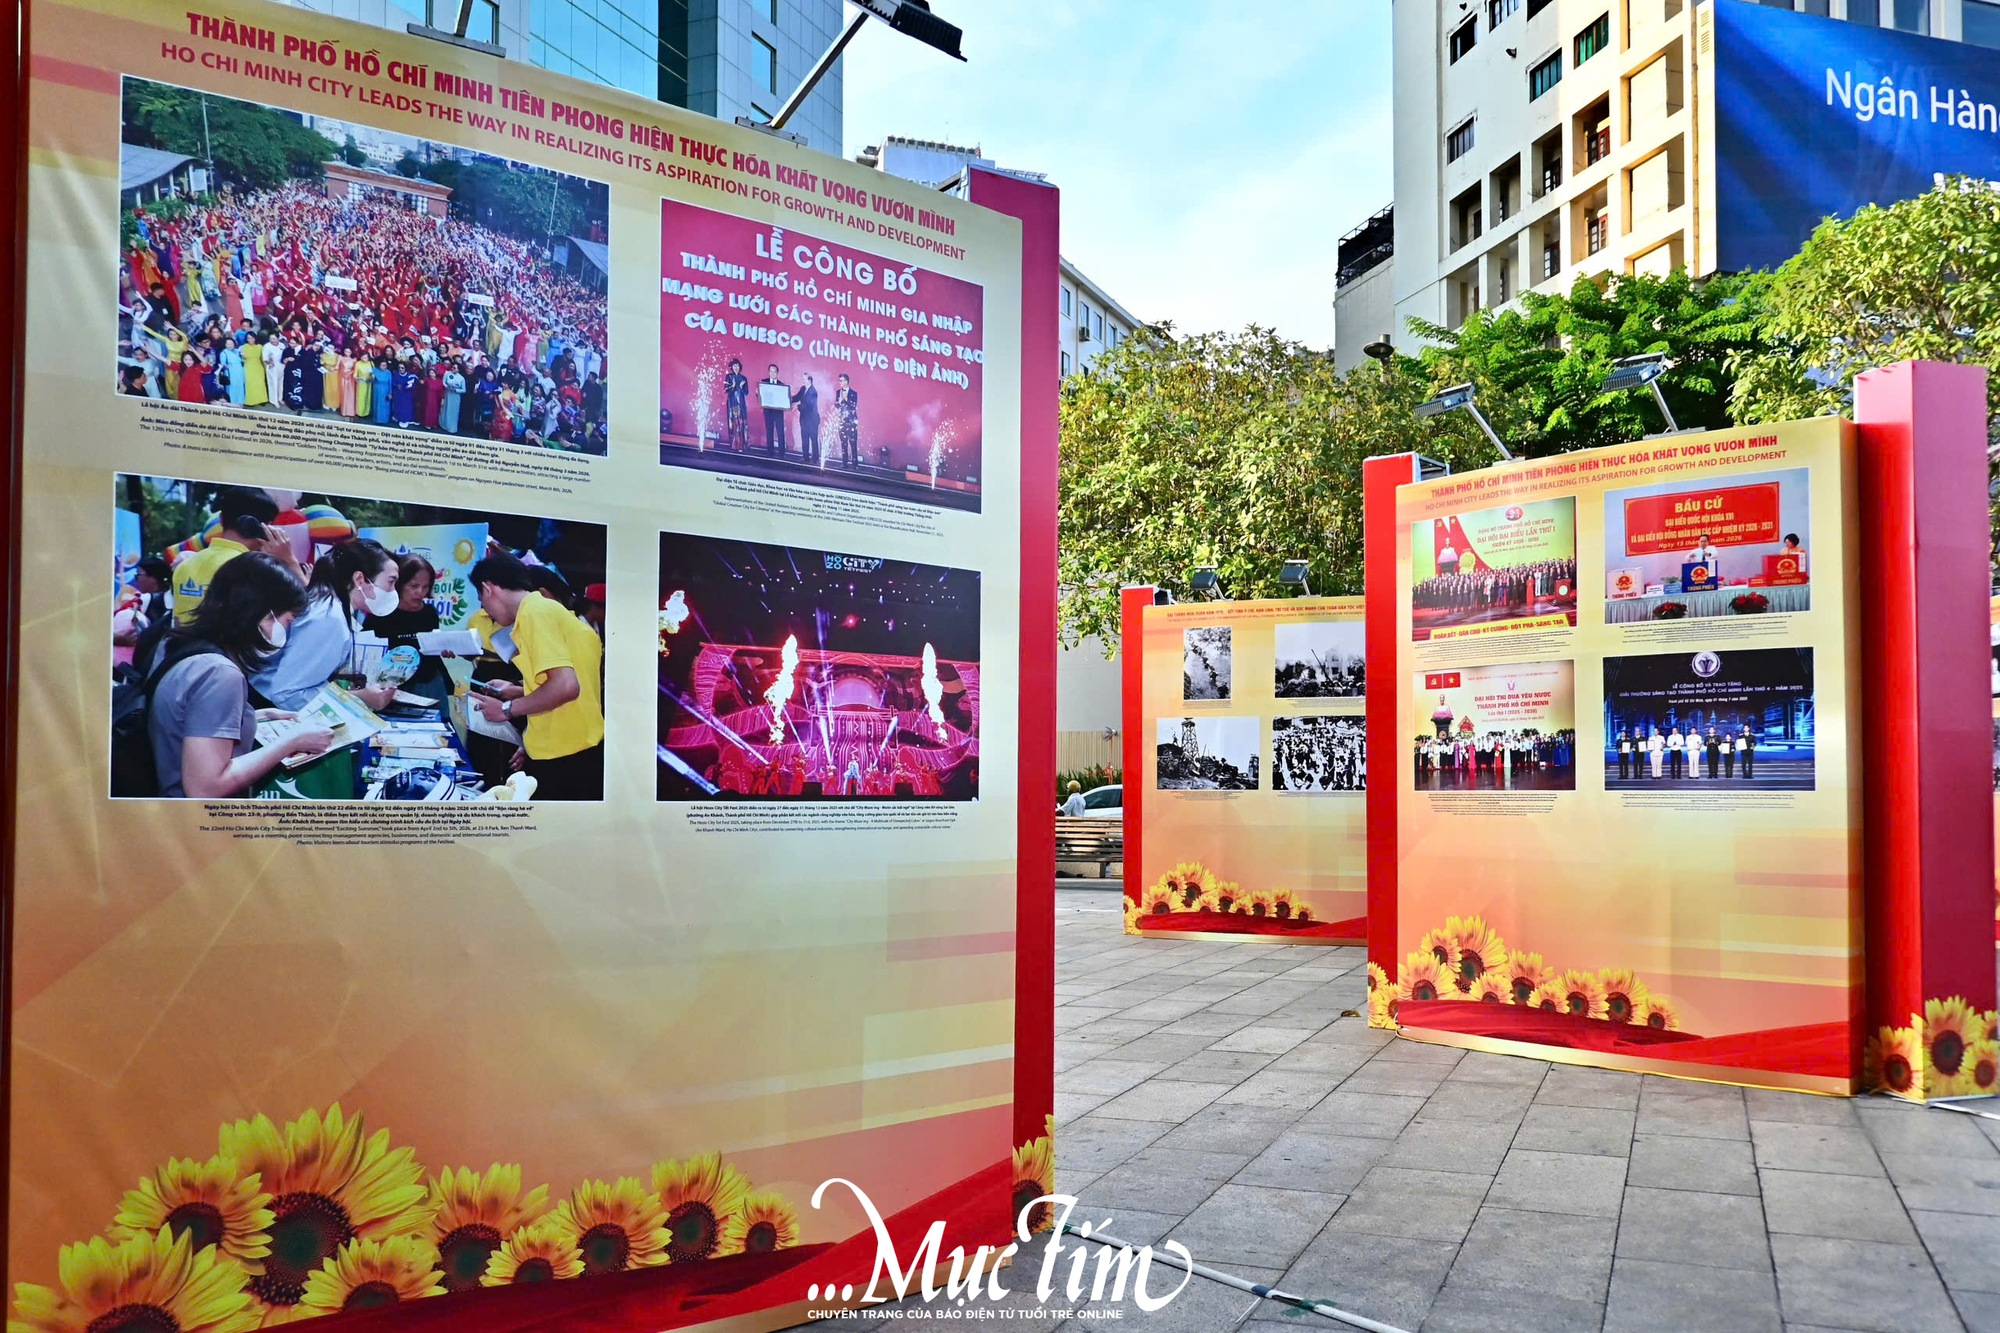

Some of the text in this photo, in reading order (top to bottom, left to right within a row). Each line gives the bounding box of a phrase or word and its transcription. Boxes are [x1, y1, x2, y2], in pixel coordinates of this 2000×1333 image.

[187, 12, 275, 53] THÀNH
[284, 38, 337, 66] PHỐ
[345, 50, 380, 76] HỒ
[388, 61, 428, 88] CHÍ
[434, 71, 492, 104] MINH
[499, 88, 544, 118] TIÊN
[552, 102, 624, 139] PHONG
[630, 123, 674, 153] HIỆN
[679, 137, 727, 167] THỰC
[733, 152, 771, 179] HÓA
[776, 164, 818, 193] KHÁT
[822, 178, 867, 208] VỌNG
[872, 194, 914, 223] VƯƠN
[918, 209, 955, 236] MÌNH
[1826, 68, 2000, 134] Ngân Hàn
[162, 42, 966, 261] HO CHI MINH CITY LEADS THE WAY IN REALIZING ITS ASPIRATION FOR GROWTH AND DEVELOPMENT
[680, 252, 972, 334] THÀNH PHỐ HỒ CHÍ MINH GIA NHẬP
[756, 226, 918, 296] LỄ CÔNG BỐ
[662, 277, 724, 304] MẠNG
[729, 293, 770, 315] LƯỚI
[776, 304, 813, 325] CÁC
[818, 314, 870, 339] THÀNH
[876, 327, 907, 347] PHỐ
[912, 334, 952, 357] SÁNG
[684, 312, 969, 390] CỦA UNESCO (LĨNH VỰC ĐIỆN ẢNH)
[1435, 501, 1447, 509] CHI
[1446, 498, 1463, 507] MINH
[1462, 495, 1477, 504] CITY
[1479, 490, 1499, 501] LEADS
[1498, 488, 1512, 497] THE
[1514, 485, 1531, 494] WAY
[1539, 477, 1577, 490] REALIZING
[1576, 476, 1590, 484] ITS
[1591, 469, 1638, 482] ASPIRATION
[1639, 466, 1656, 475] FOR
[1657, 461, 1696, 472] GROWTH
[1698, 458, 1717, 467] AND
[1719, 450, 1787, 465] DEVELOPMENT
[1502, 472, 1523, 484] MINH
[1546, 463, 1576, 476] PHONG
[1681, 443, 1711, 456] VỌNG
[1748, 435, 1777, 448] MÌNH
[1675, 496, 1723, 514] BẦU CỬ
